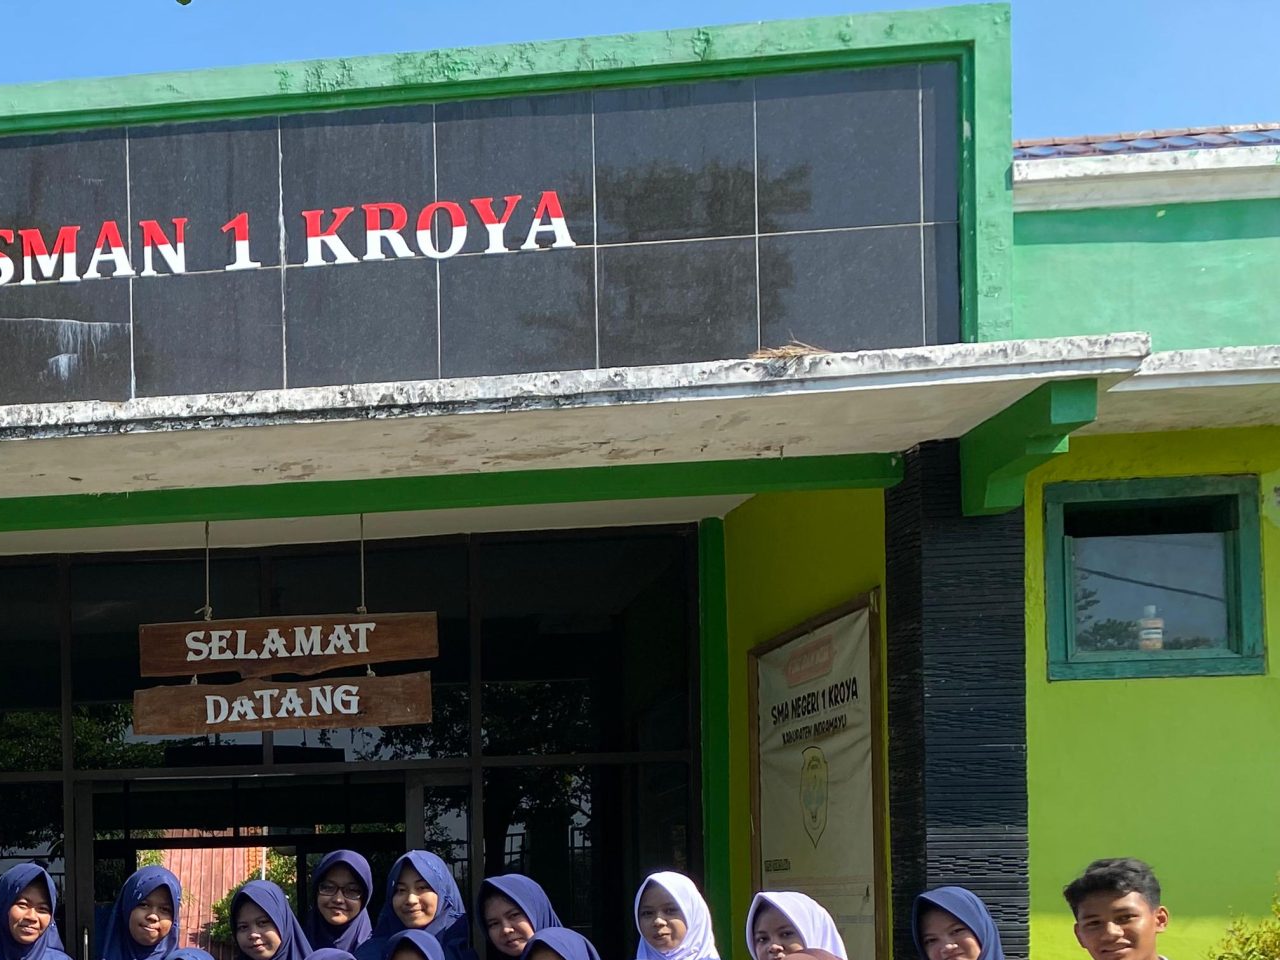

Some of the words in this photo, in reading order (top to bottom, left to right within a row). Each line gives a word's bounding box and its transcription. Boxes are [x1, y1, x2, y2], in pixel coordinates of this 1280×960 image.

[221, 211, 261, 271] 1
[302, 190, 577, 267] KROYA
[185, 622, 376, 662] SELAMAT
[205, 685, 360, 725] DATANG
[771, 701, 790, 726] SMA
[791, 689, 820, 719] NEGERI
[821, 689, 826, 710] 1
[828, 676, 858, 708] KROYA
